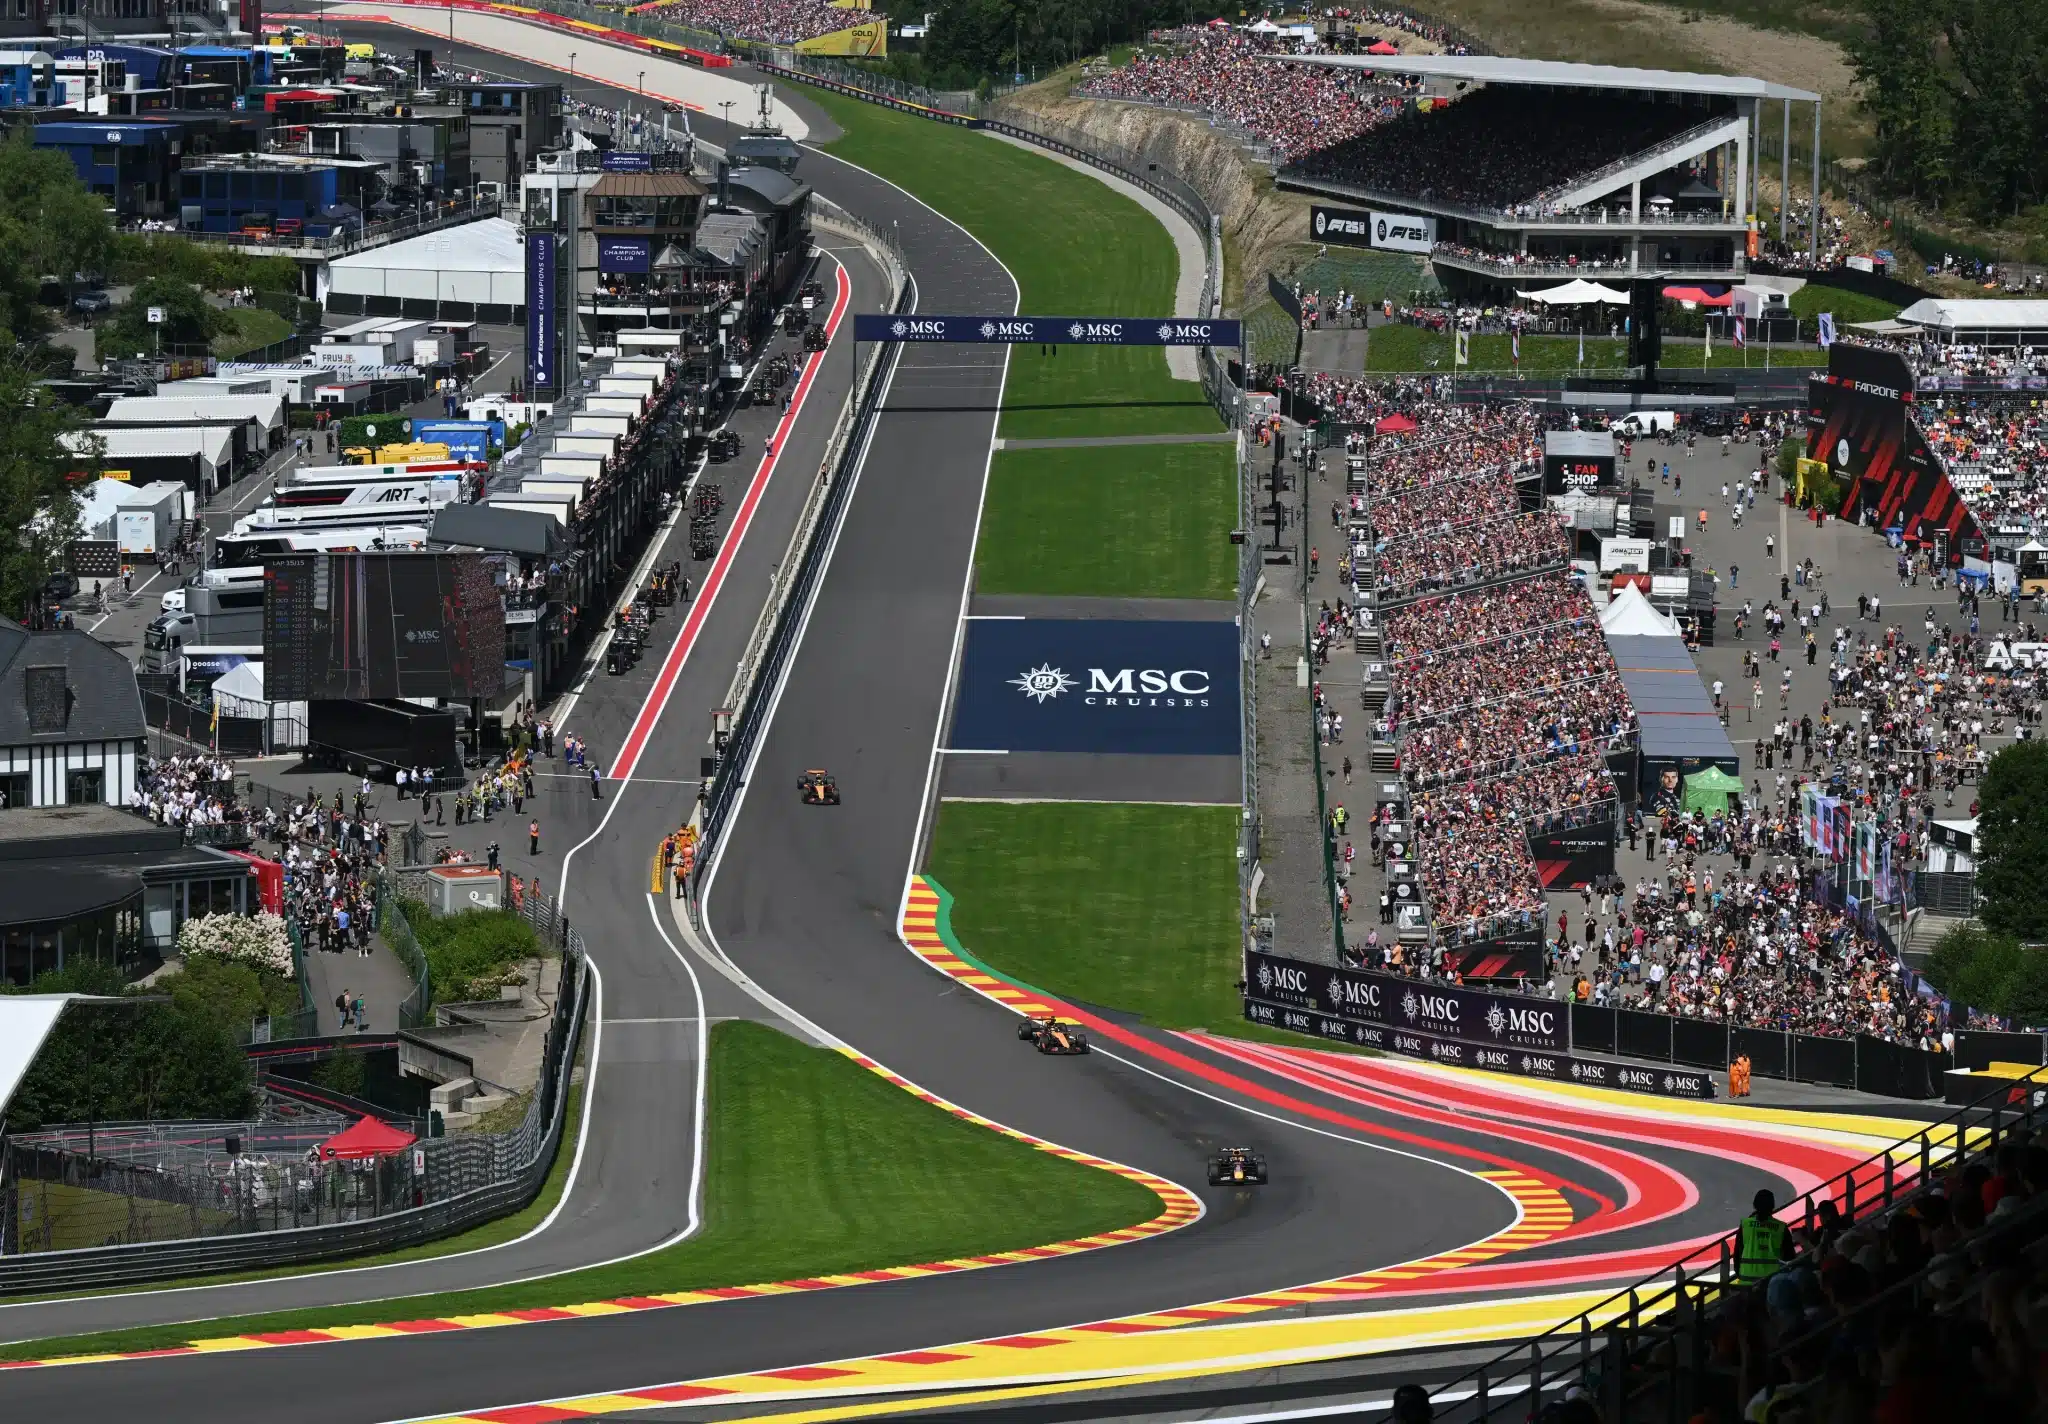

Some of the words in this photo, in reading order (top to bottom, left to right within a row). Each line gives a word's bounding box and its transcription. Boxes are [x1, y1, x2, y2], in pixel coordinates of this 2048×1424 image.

[107, 132, 121, 141] FIA
[909, 321, 945, 334] MSC
[998, 322, 1033, 335] MSC
[1087, 324, 1122, 337] MSC
[1176, 325, 1211, 338] MSC
[322, 354, 343, 362] FRUY
[1854, 380, 1899, 400] FANZONE
[1574, 464, 1599, 474] FAN
[1567, 474, 1599, 485] SHOP
[376, 487, 415, 503] ART
[2038, 551, 2048, 560] BA
[418, 630, 440, 639] MSC
[1086, 668, 1210, 694] MSC
[1084, 697, 1210, 707] CRUISES
[1946, 830, 1956, 842] BAR
[1274, 966, 1307, 993] MSC
[1275, 991, 1309, 1004] CRUISES
[1345, 980, 1380, 1007] MSC
[1258, 1006, 1275, 1020] MSC
[1345, 1006, 1382, 1019] CRUISES
[1420, 994, 1460, 1022] MSC
[1292, 1013, 1310, 1027] MSC
[1422, 1020, 1461, 1034] CRUISES
[1509, 1008, 1554, 1035] MSC
[1329, 1021, 1346, 1035] MSC
[1365, 1028, 1382, 1042] MSC
[1402, 1036, 1421, 1051] MSC
[1509, 1034, 1556, 1047] CRUISES
[1440, 1043, 1462, 1058] MSC
[1487, 1051, 1509, 1065] MSC
[1533, 1057, 1555, 1071] MSC
[1582, 1064, 1605, 1079] MSC
[1630, 1071, 1654, 1085] MSC
[1676, 1076, 1700, 1091] MSC
